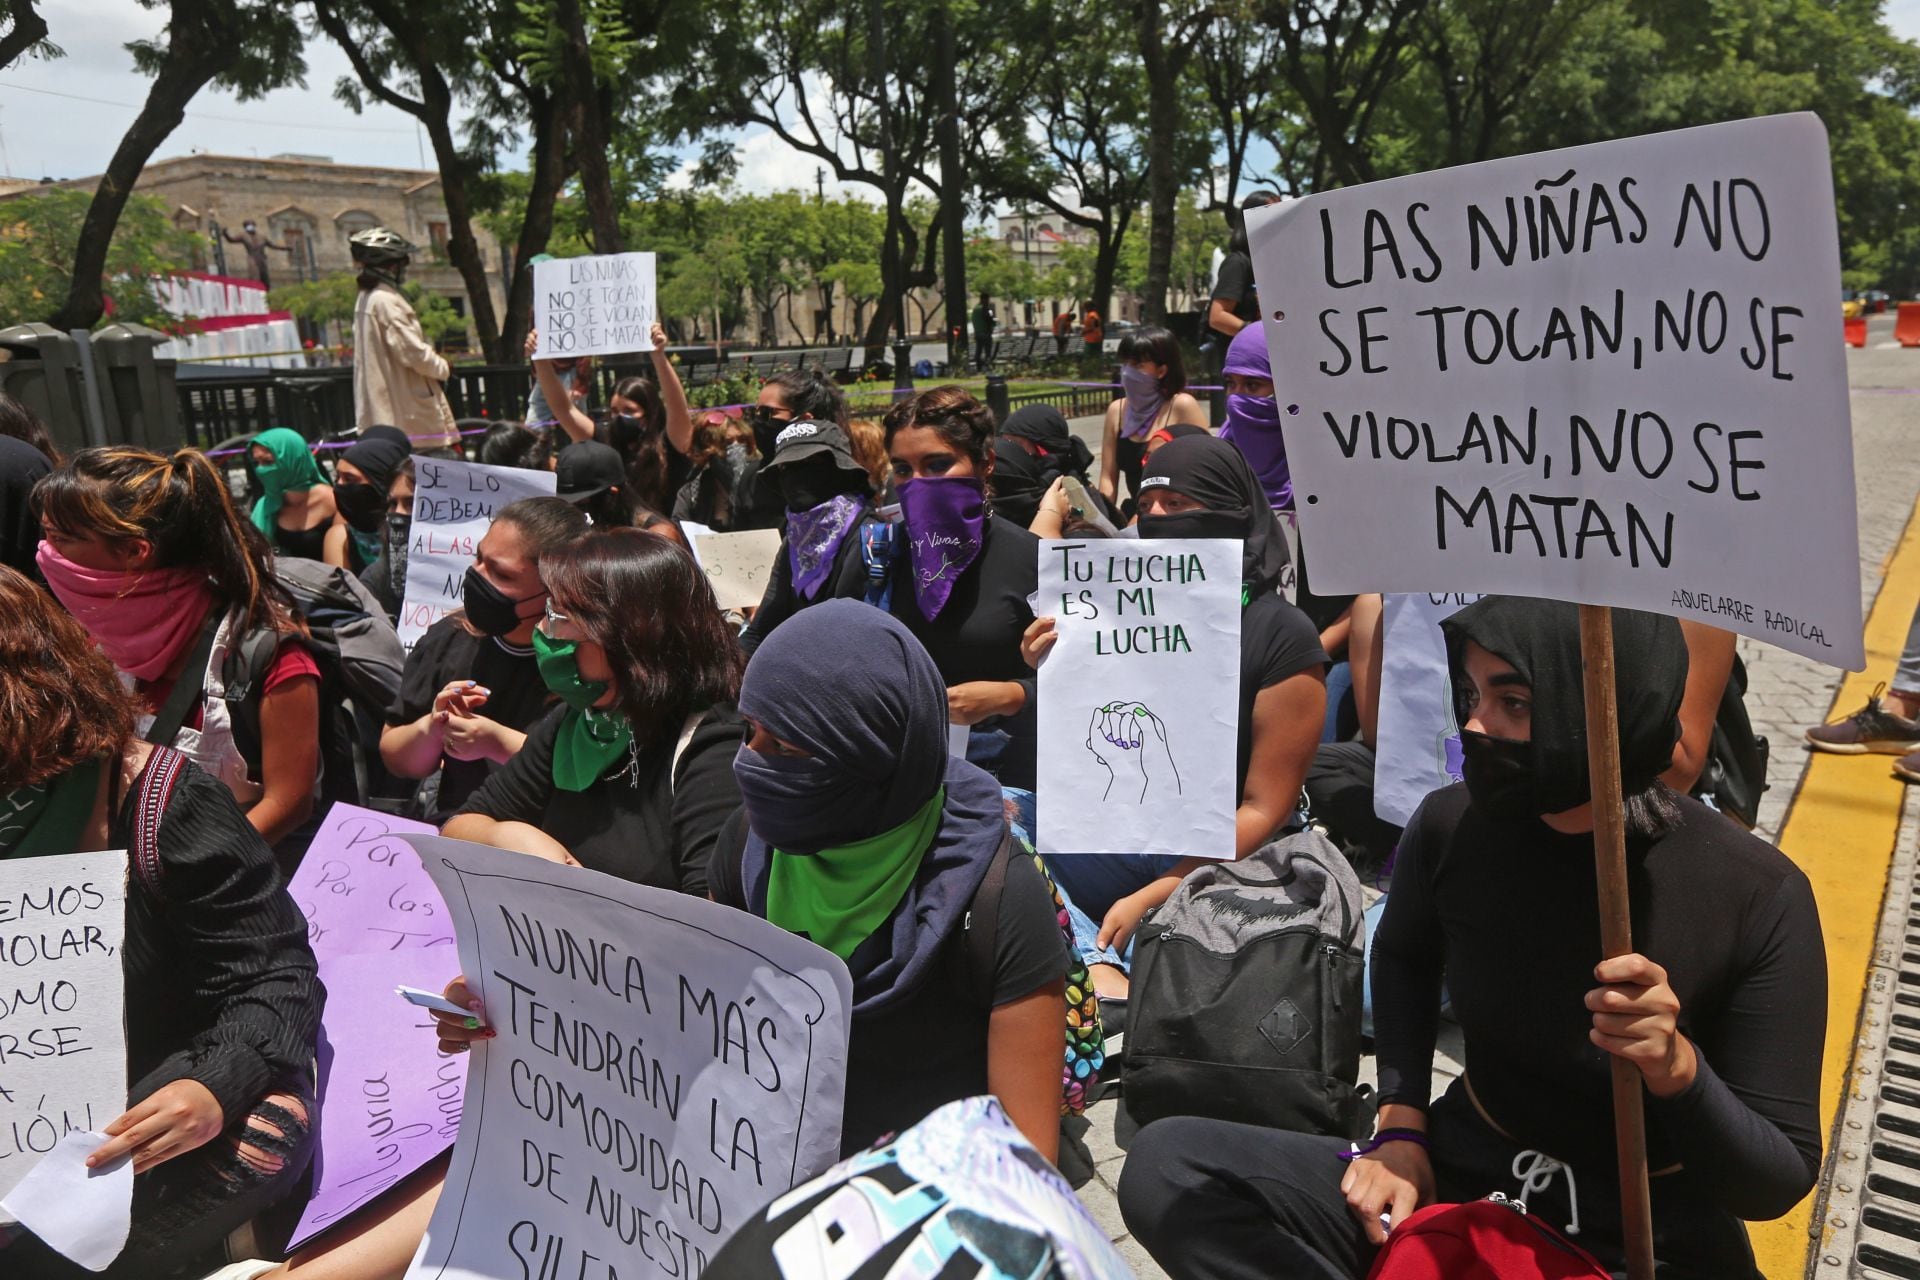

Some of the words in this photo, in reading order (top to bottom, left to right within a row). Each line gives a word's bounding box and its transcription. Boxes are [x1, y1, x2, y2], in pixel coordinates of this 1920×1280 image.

[1320, 202, 1442, 289] LAS
[1468, 169, 1648, 271] NIÑAS
[1673, 178, 1771, 262] NO
[549, 291, 576, 310] NO
[578, 288, 595, 307] SE
[601, 285, 645, 304] TOCAN
[549, 312, 576, 331] NO
[578, 307, 599, 327] SE
[603, 305, 652, 323] VIOLAN
[549, 331, 576, 352] NO
[578, 328, 601, 349] SE
[1319, 306, 1389, 377] SE
[1416, 289, 1642, 370] TOCAN,
[1654, 289, 1728, 354] NO
[1740, 297, 1804, 380] SE
[421, 463, 448, 489] SE
[468, 471, 500, 493] LO
[1322, 406, 1552, 480] VIOLAN,
[1571, 408, 1674, 479] NO
[1687, 422, 1766, 502] SE
[925, 531, 961, 549] Vivas
[1436, 485, 1675, 569] MATAN
[1107, 553, 1206, 584] LUCHA
[1061, 589, 1099, 620] ES
[1117, 587, 1156, 616] MI
[1671, 589, 1754, 623] AQUELARRE
[1765, 609, 1832, 648] RADICAL
[1095, 624, 1192, 656] LUCHA
[337, 817, 400, 867] Por
[315, 860, 356, 897] Por
[388, 883, 434, 916] las
[499, 904, 651, 1015] NUNCA
[678, 974, 781, 1093] MÁS
[494, 970, 681, 1122] TENDRÁN
[710, 1098, 763, 1186] LA
[510, 1059, 723, 1235] COMODIDAD
[522, 1139, 568, 1204] DE
